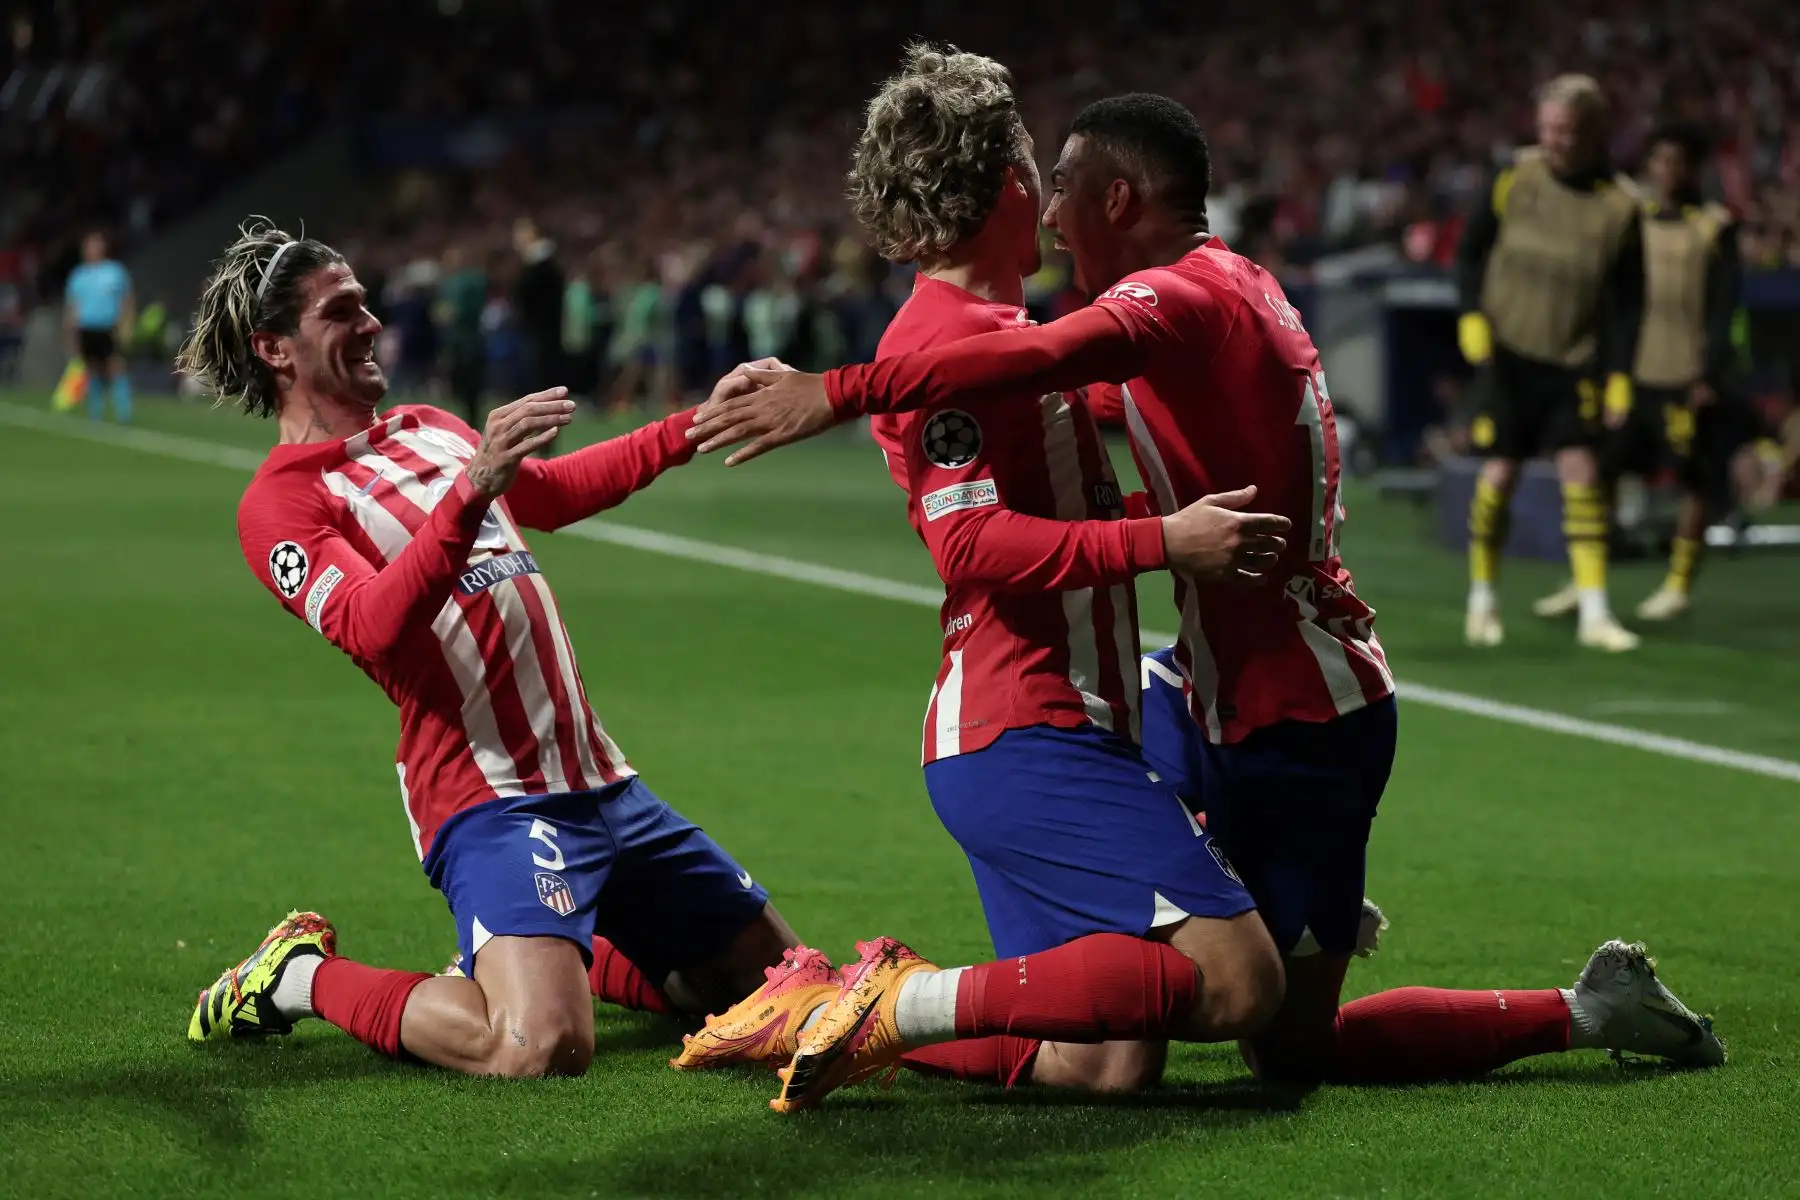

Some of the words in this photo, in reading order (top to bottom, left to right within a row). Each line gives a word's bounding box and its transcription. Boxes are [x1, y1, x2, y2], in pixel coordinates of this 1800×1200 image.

[925, 486, 995, 513] FOUNDATION
[460, 554, 527, 593] RIYADH
[528, 818, 566, 871] 5
